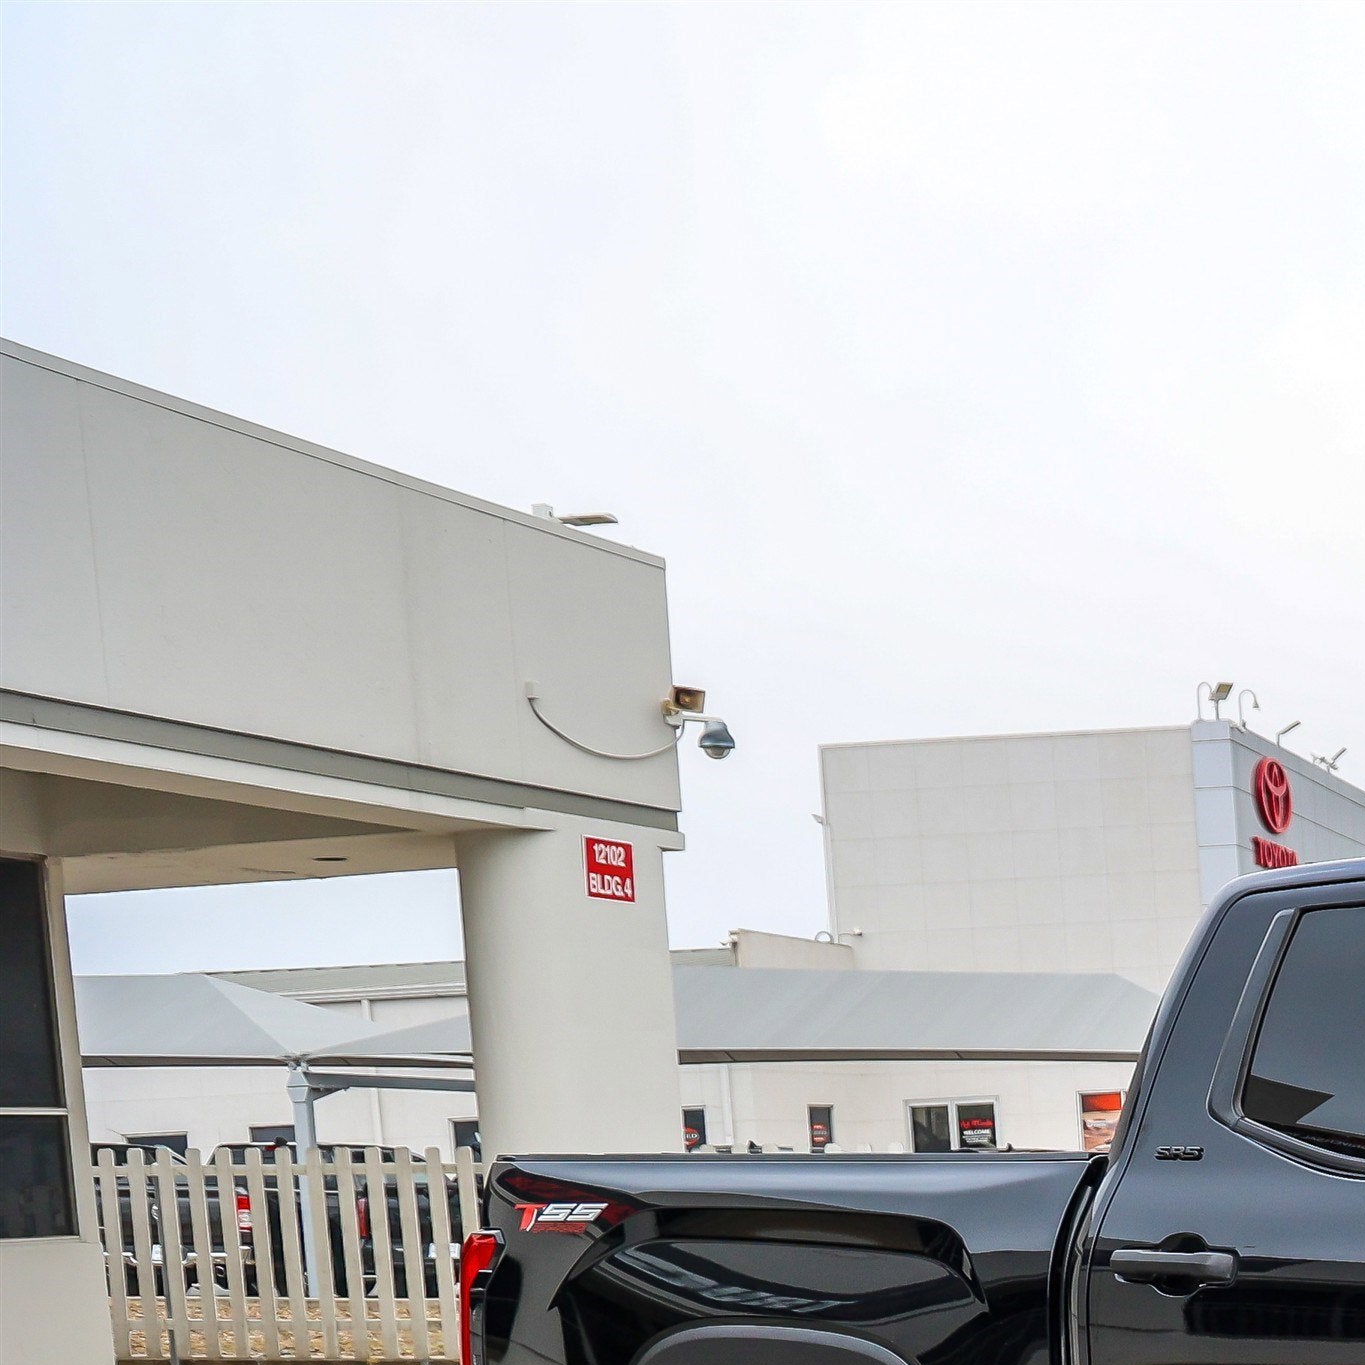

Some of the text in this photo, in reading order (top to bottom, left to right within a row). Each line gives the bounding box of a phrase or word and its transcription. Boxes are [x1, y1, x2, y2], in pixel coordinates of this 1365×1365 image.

[593, 843, 626, 867] 12102
[624, 877, 634, 899] 4
[1154, 1145, 1204, 1161] SR5
